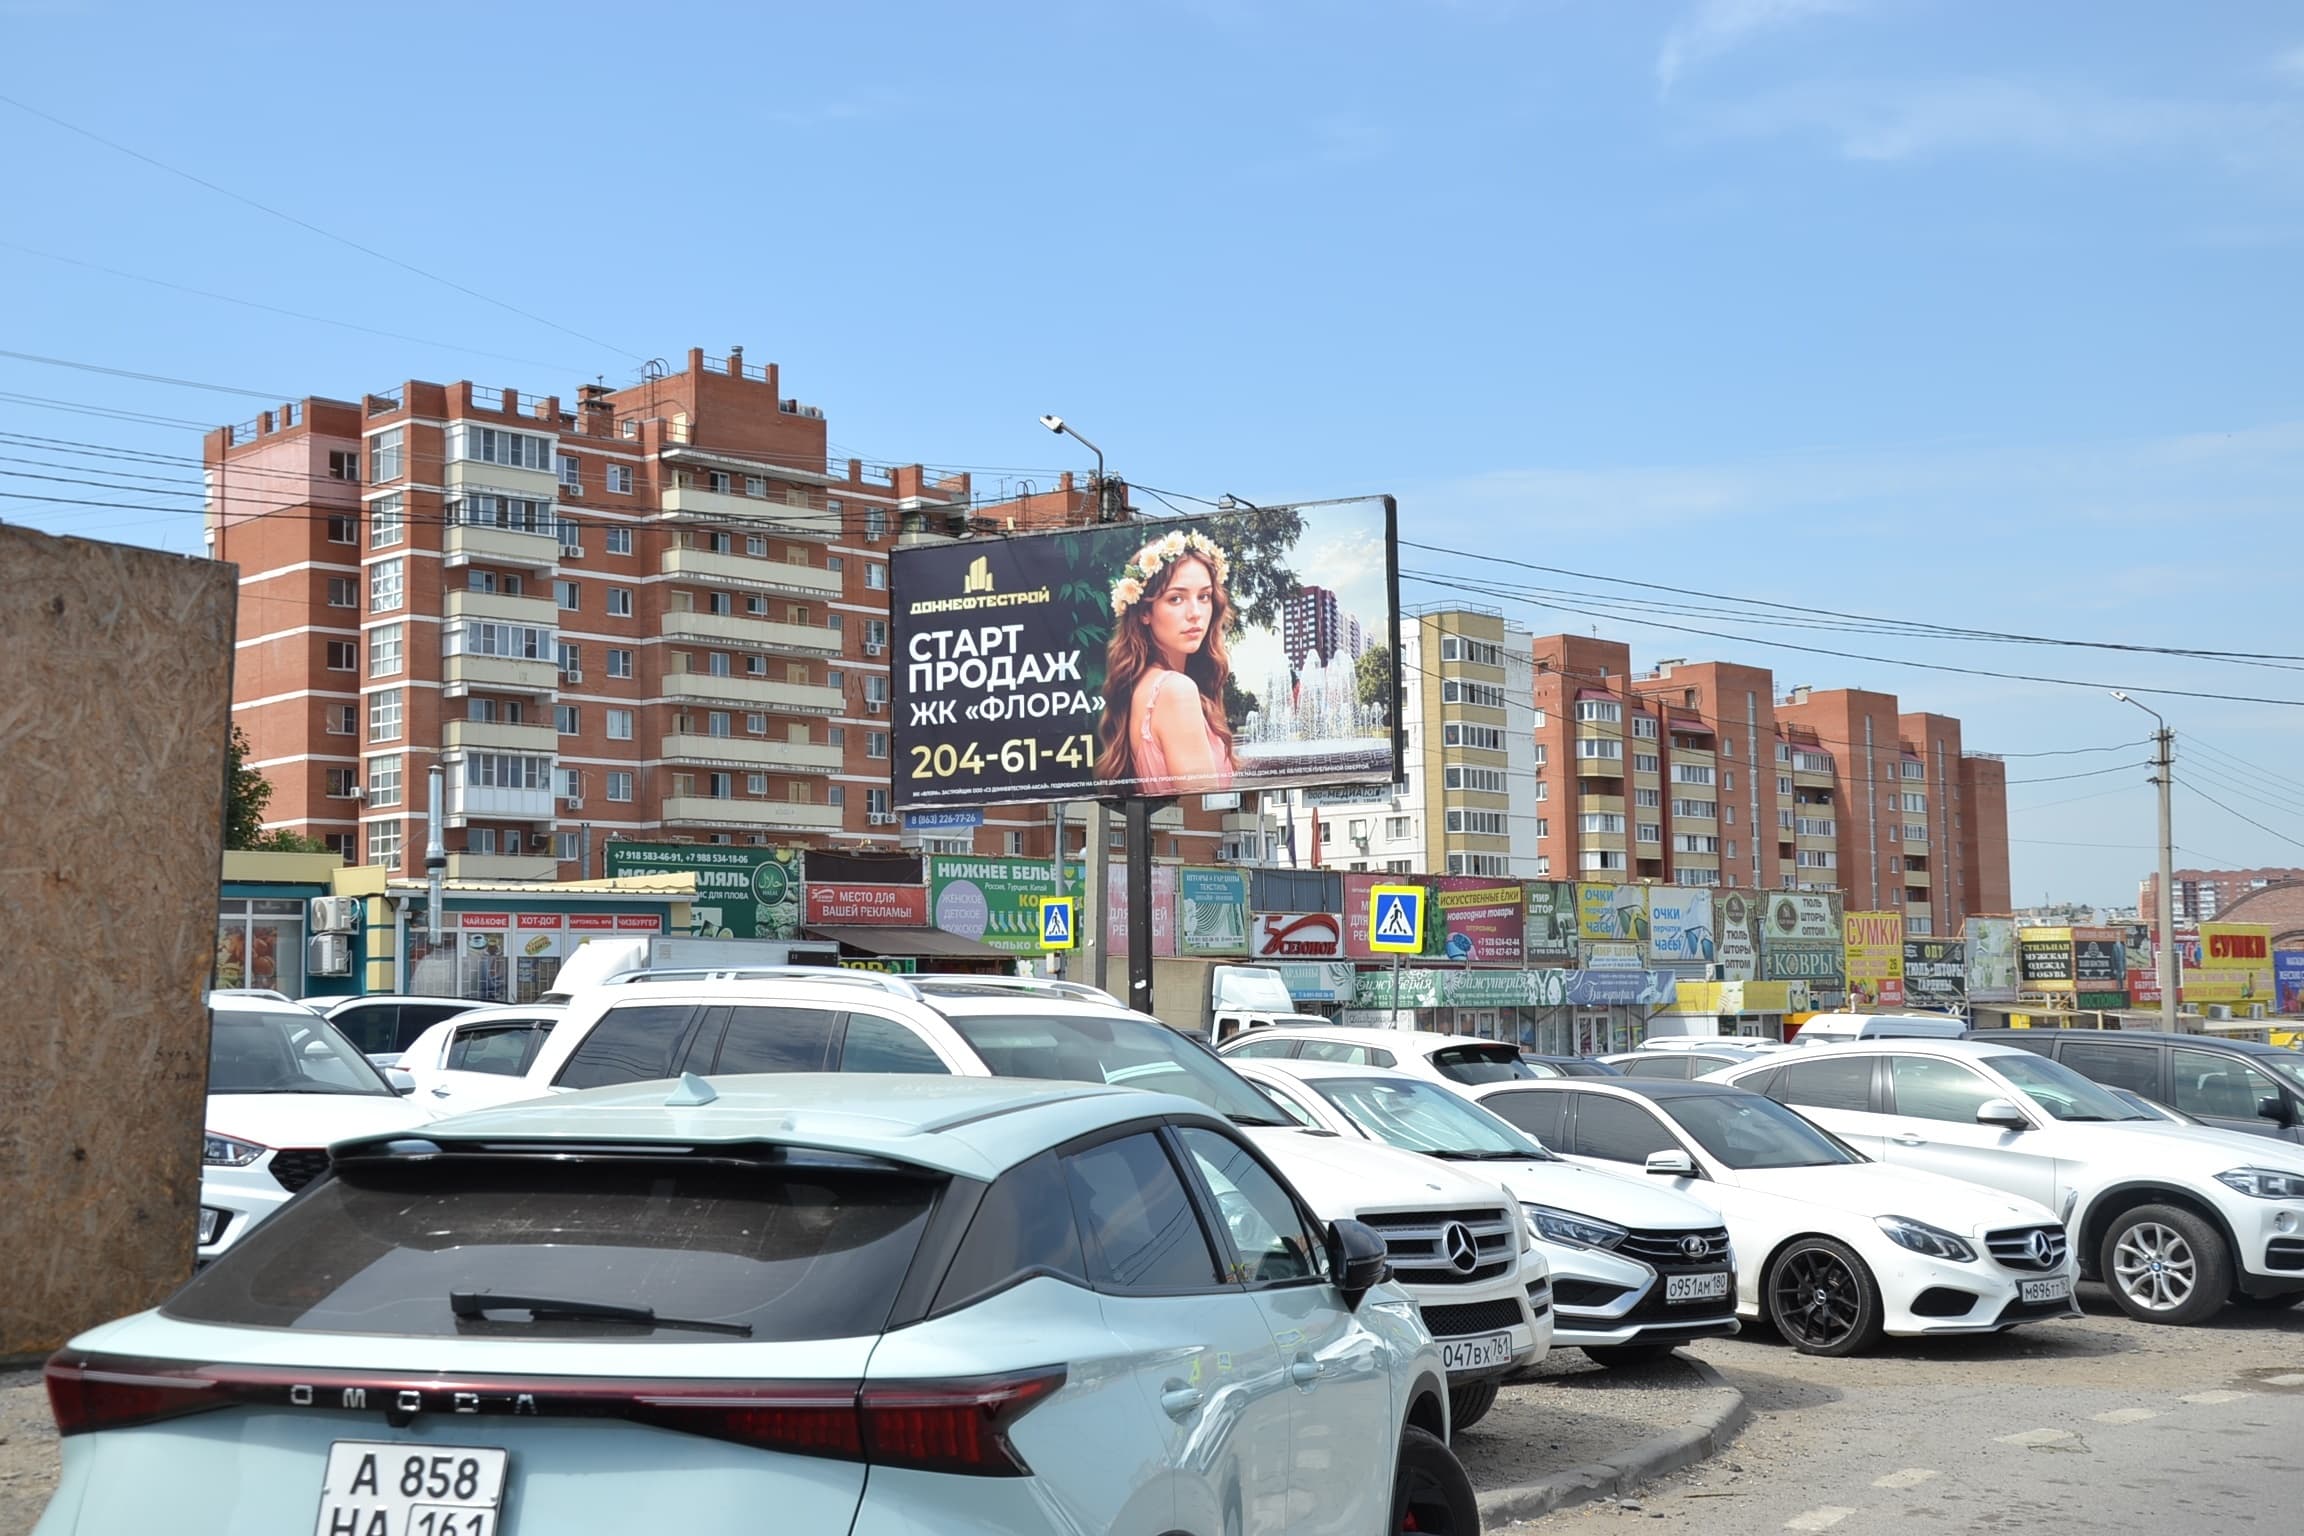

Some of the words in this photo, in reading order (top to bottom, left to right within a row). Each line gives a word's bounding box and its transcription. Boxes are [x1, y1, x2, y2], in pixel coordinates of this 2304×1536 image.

[910, 585, 1050, 615] ДОННЕФТЕСТРОЙ
[909, 624, 1024, 662] СТАРТ
[909, 650, 1081, 693] ПРОДАЖ
[910, 700, 957, 727] ЖК
[965, 690, 1106, 722] «ФЛОРА»
[910, 734, 1094, 779] 204-61-41
[912, 816, 917, 825] 8
[918, 814, 937, 825] (863)
[939, 813, 976, 823] 226-77-26
[614, 851, 624, 860] +7
[626, 851, 641, 860] 918
[643, 852, 683, 863] 583-46-91,
[686, 853, 695, 861] +7
[696, 853, 710, 862] 988
[712, 854, 748, 864] 534-18-06
[938, 862, 1008, 880] НИЖНЕЕ
[693, 871, 750, 888] АЛЯЛЬ
[708, 891, 722, 900] ДЛЯ
[723, 892, 749, 900] ПЛОВА
[840, 892, 873, 903] МЕСТО
[875, 893, 895, 904] ДЛЯ
[942, 895, 983, 904] ЖЕНСКОЕ
[1440, 892, 1499, 906] ИСКУССТВЕННЫЕ
[1501, 890, 1519, 902] ЁЛКИ
[1532, 894, 1549, 903] МИР
[1529, 904, 1553, 914] ШТОР
[1802, 898, 1823, 908] ТЮЛЬ
[822, 904, 858, 917] ВАШЕЙ
[861, 906, 912, 918] РЕКЛАМЫ!
[943, 910, 980, 919] ДЕТСКОЕ
[1487, 908, 1514, 918] товары
[1800, 912, 1826, 922] ШТОРЫ
[521, 916, 557, 926] ХОТ-ДОГ
[618, 918, 658, 927] ЧИЗБУРГЕР
[941, 924, 983, 934] МУЖСКОЕ
[1726, 930, 1748, 940] ТЮЛЬ
[1802, 926, 1826, 936] ОПТОМ
[1847, 917, 1900, 946] СУМКИ
[1280, 941, 1337, 955] СЕЗОНОВ
[1655, 938, 1681, 951] часы
[1723, 944, 1751, 954] ШТОРЫ
[2023, 943, 2070, 952] СТИЛЬНАЯ
[2209, 934, 2267, 958] СУМКИ
[1924, 944, 1943, 959] ОПТ
[2024, 952, 2069, 960] МУЖСКАЯ
[1725, 959, 1751, 969] ОПТОМ
[1774, 953, 1834, 975] КОВРЫ
[1934, 962, 1964, 977] ШТОРЫ
[2028, 961, 2066, 969] ОДЕЖДА
[1670, 1278, 1710, 1297] О951АМ
[1712, 1275, 1726, 1288] 180
[1443, 1342, 1490, 1367] 047ВХ
[1492, 1337, 1508, 1356] 761
[350, 1453, 377, 1496] А
[400, 1455, 480, 1500] 858
[328, 1505, 387, 1536] НА
[418, 1511, 485, 1536] 161
